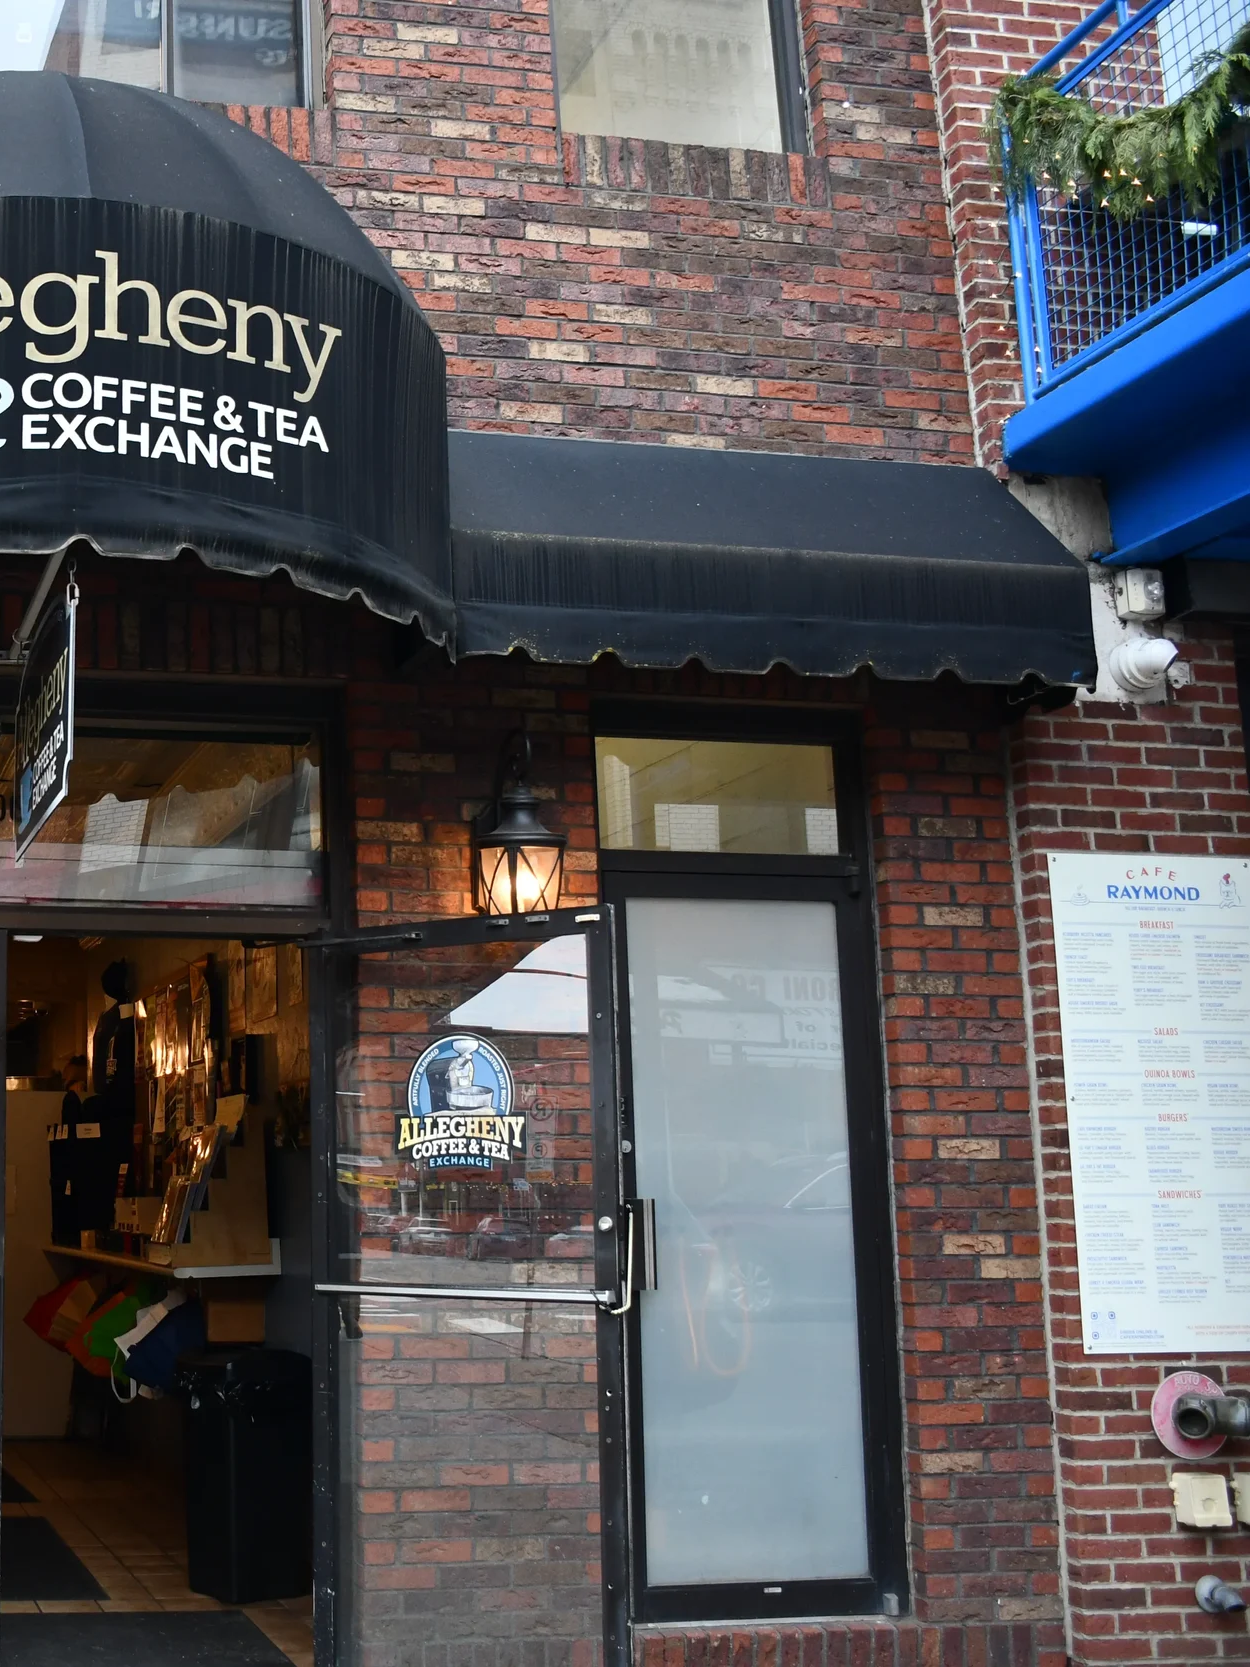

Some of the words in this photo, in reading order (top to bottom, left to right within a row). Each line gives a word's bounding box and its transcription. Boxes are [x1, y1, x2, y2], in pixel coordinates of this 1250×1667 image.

[21, 372, 205, 425] COFFEE
[212, 395, 245, 431] &
[249, 401, 329, 453] TEA
[21, 414, 275, 479] EXCHANGE
[1126, 867, 1177, 882] CAFE
[1107, 884, 1200, 901] RAYMOND
[1139, 921, 1174, 930] BREAKFAST
[1154, 1027, 1179, 1037] SALADS
[478, 1046, 501, 1074] ROASTED
[497, 1072, 507, 1090] JUST
[1144, 1069, 1170, 1078] QUINOA
[1171, 1069, 1196, 1079] BOWLS
[412, 1074, 421, 1106] ARTFULLY
[418, 1048, 439, 1074] BLENDED
[1158, 1113, 1187, 1122] BURGERS
[398, 1116, 525, 1149] ALLEGHENY
[412, 1138, 467, 1160] COFFEE
[468, 1138, 481, 1154] &
[482, 1141, 510, 1161] TEA
[430, 1156, 490, 1168] EXCHANGE
[1158, 1190, 1201, 1199] SANDWICHES
